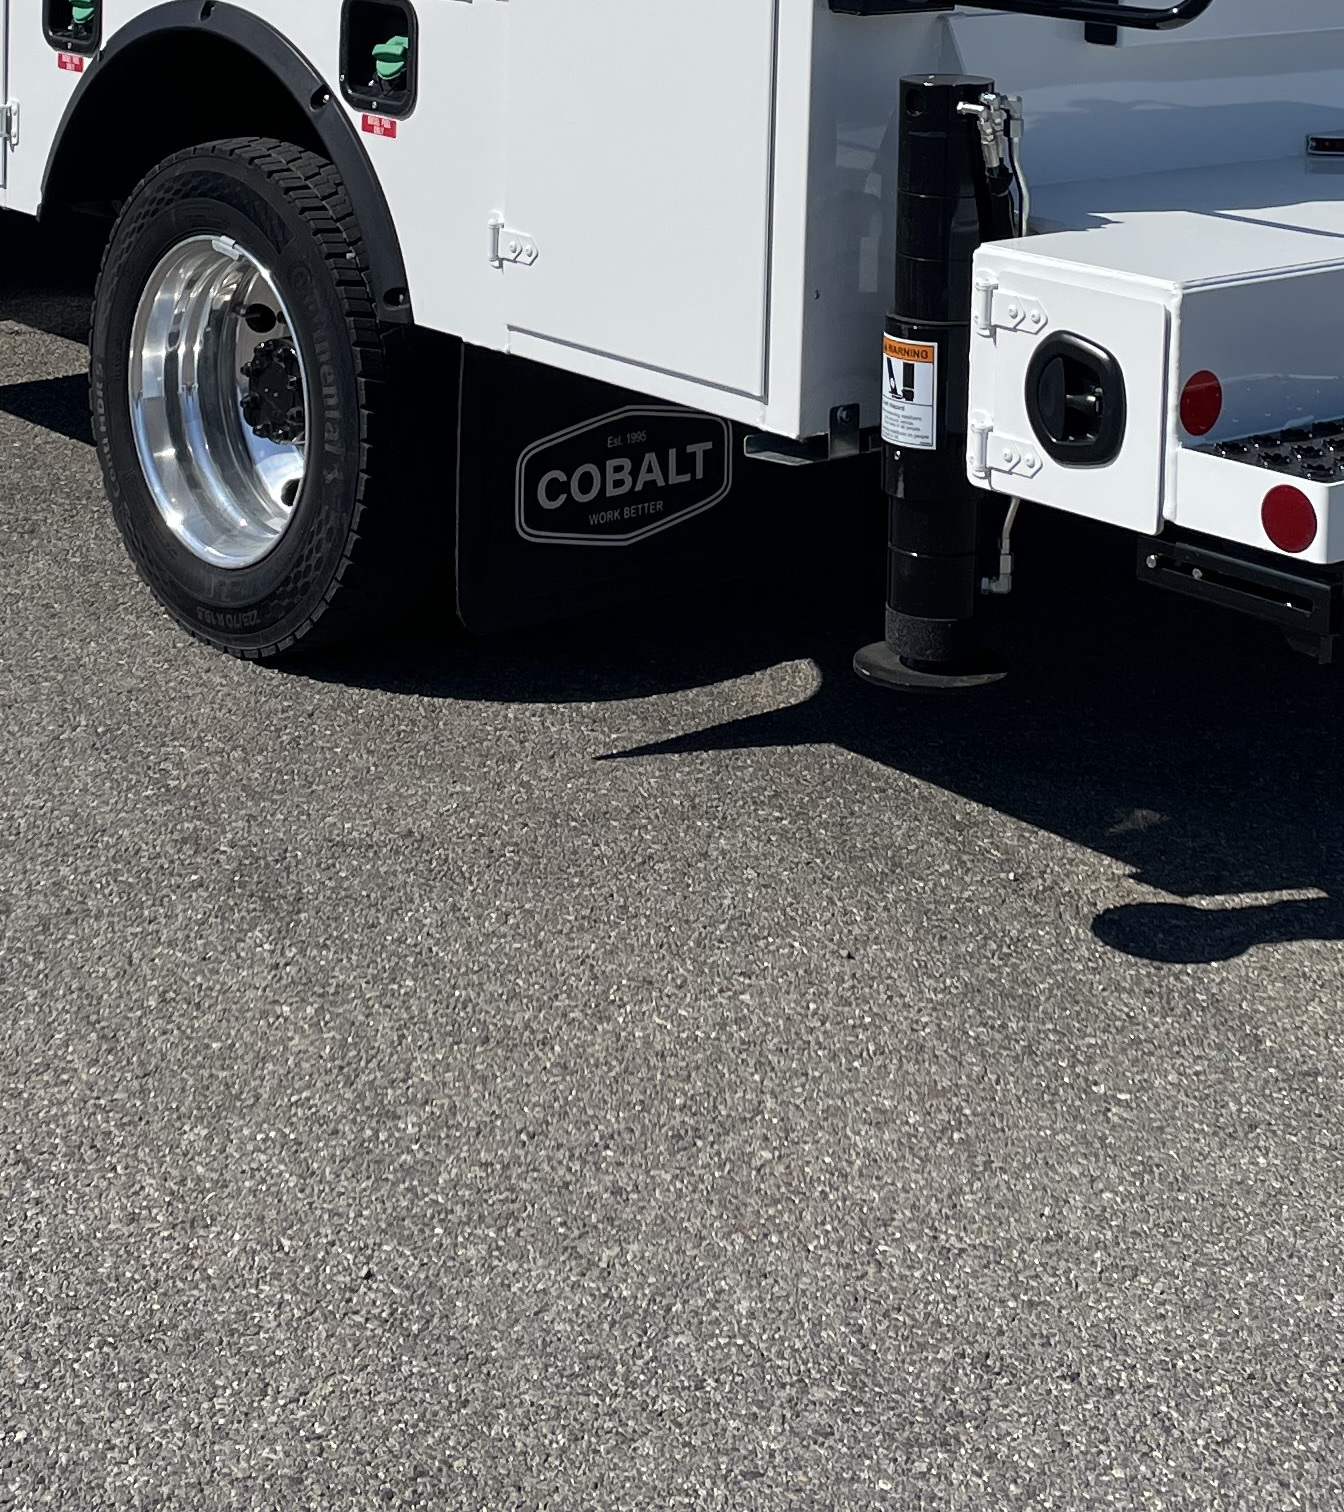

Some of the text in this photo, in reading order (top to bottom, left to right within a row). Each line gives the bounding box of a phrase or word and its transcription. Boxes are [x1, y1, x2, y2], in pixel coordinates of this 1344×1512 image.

[888, 344, 929, 360] WARNING
[536, 440, 714, 510] COBALT
[589, 500, 664, 525] WORK BETTER
